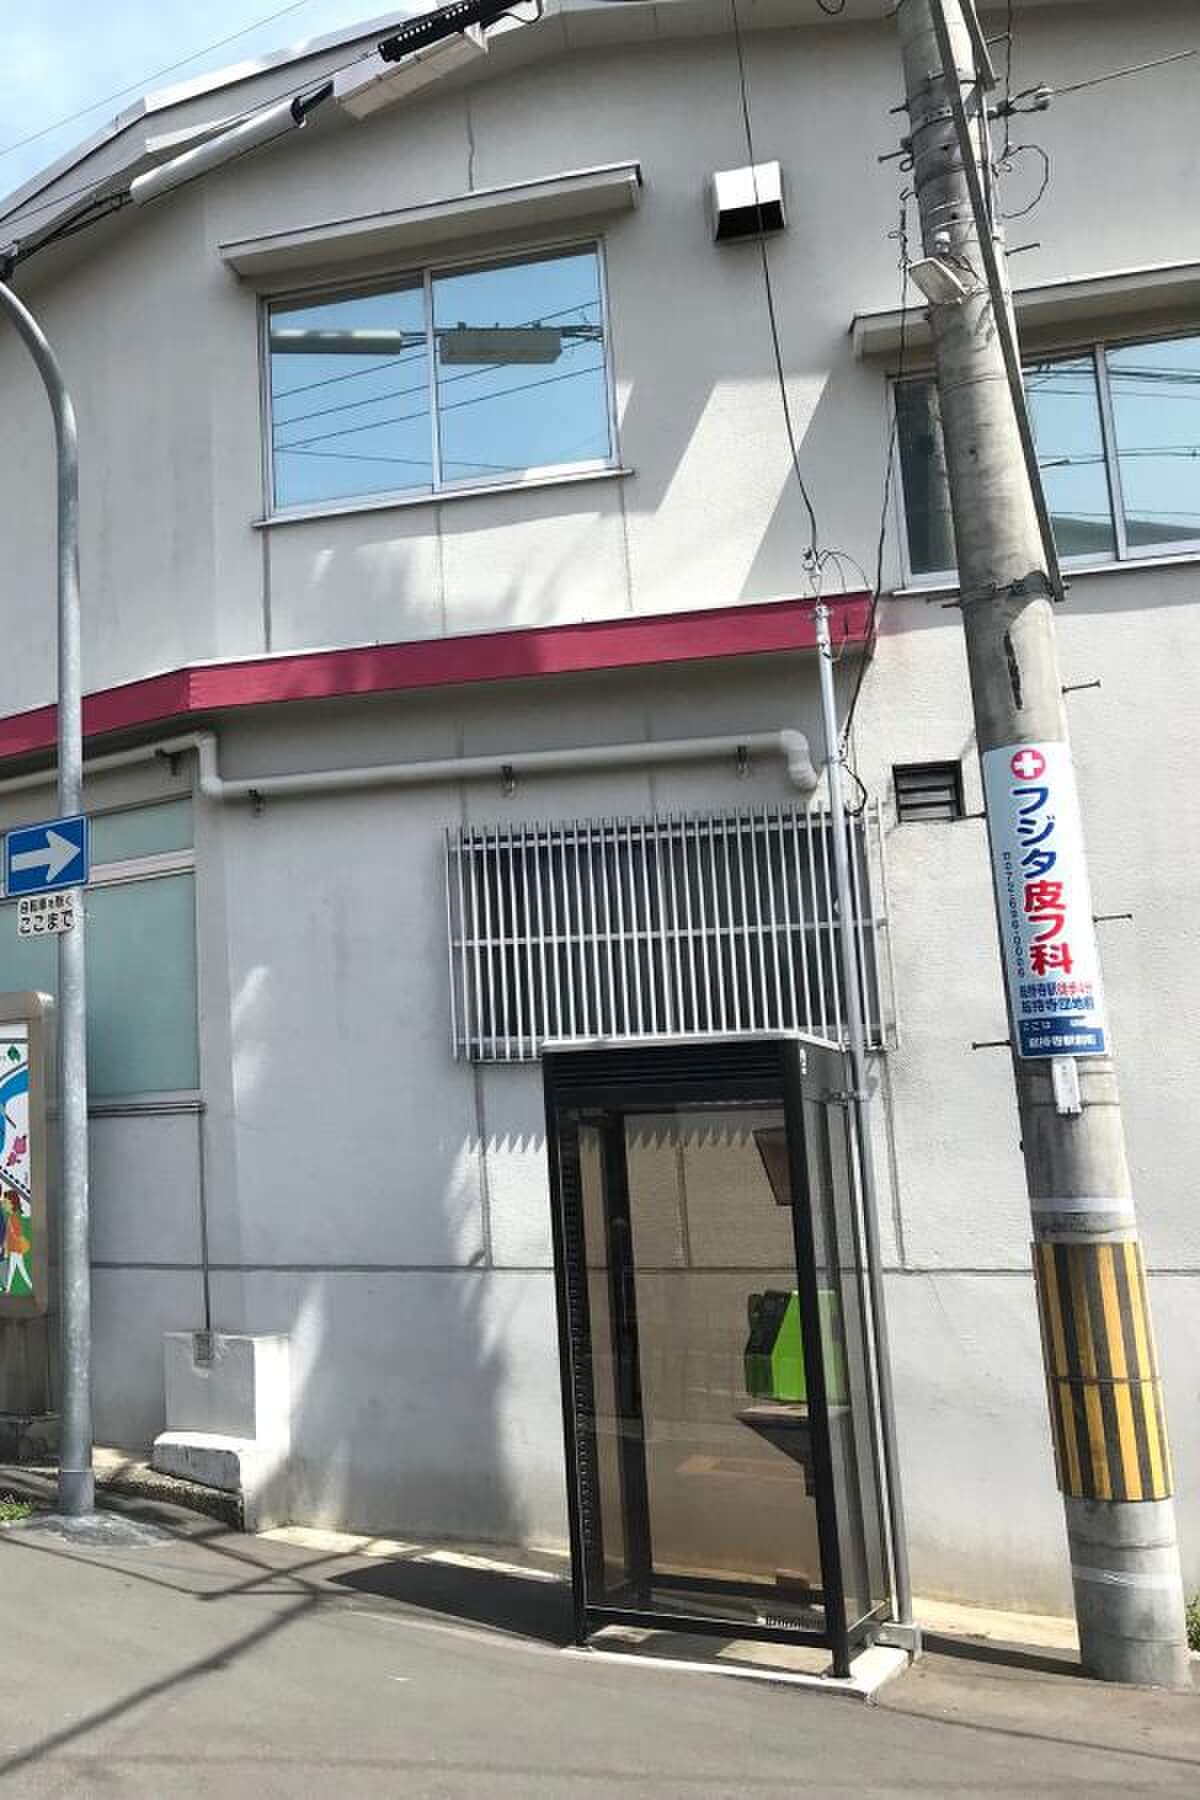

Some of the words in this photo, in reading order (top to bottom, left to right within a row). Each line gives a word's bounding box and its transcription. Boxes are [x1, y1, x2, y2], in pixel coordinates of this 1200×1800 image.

[20, 910, 74, 934] ここまで
[1011, 786, 1074, 977] フジタ皮フ科
